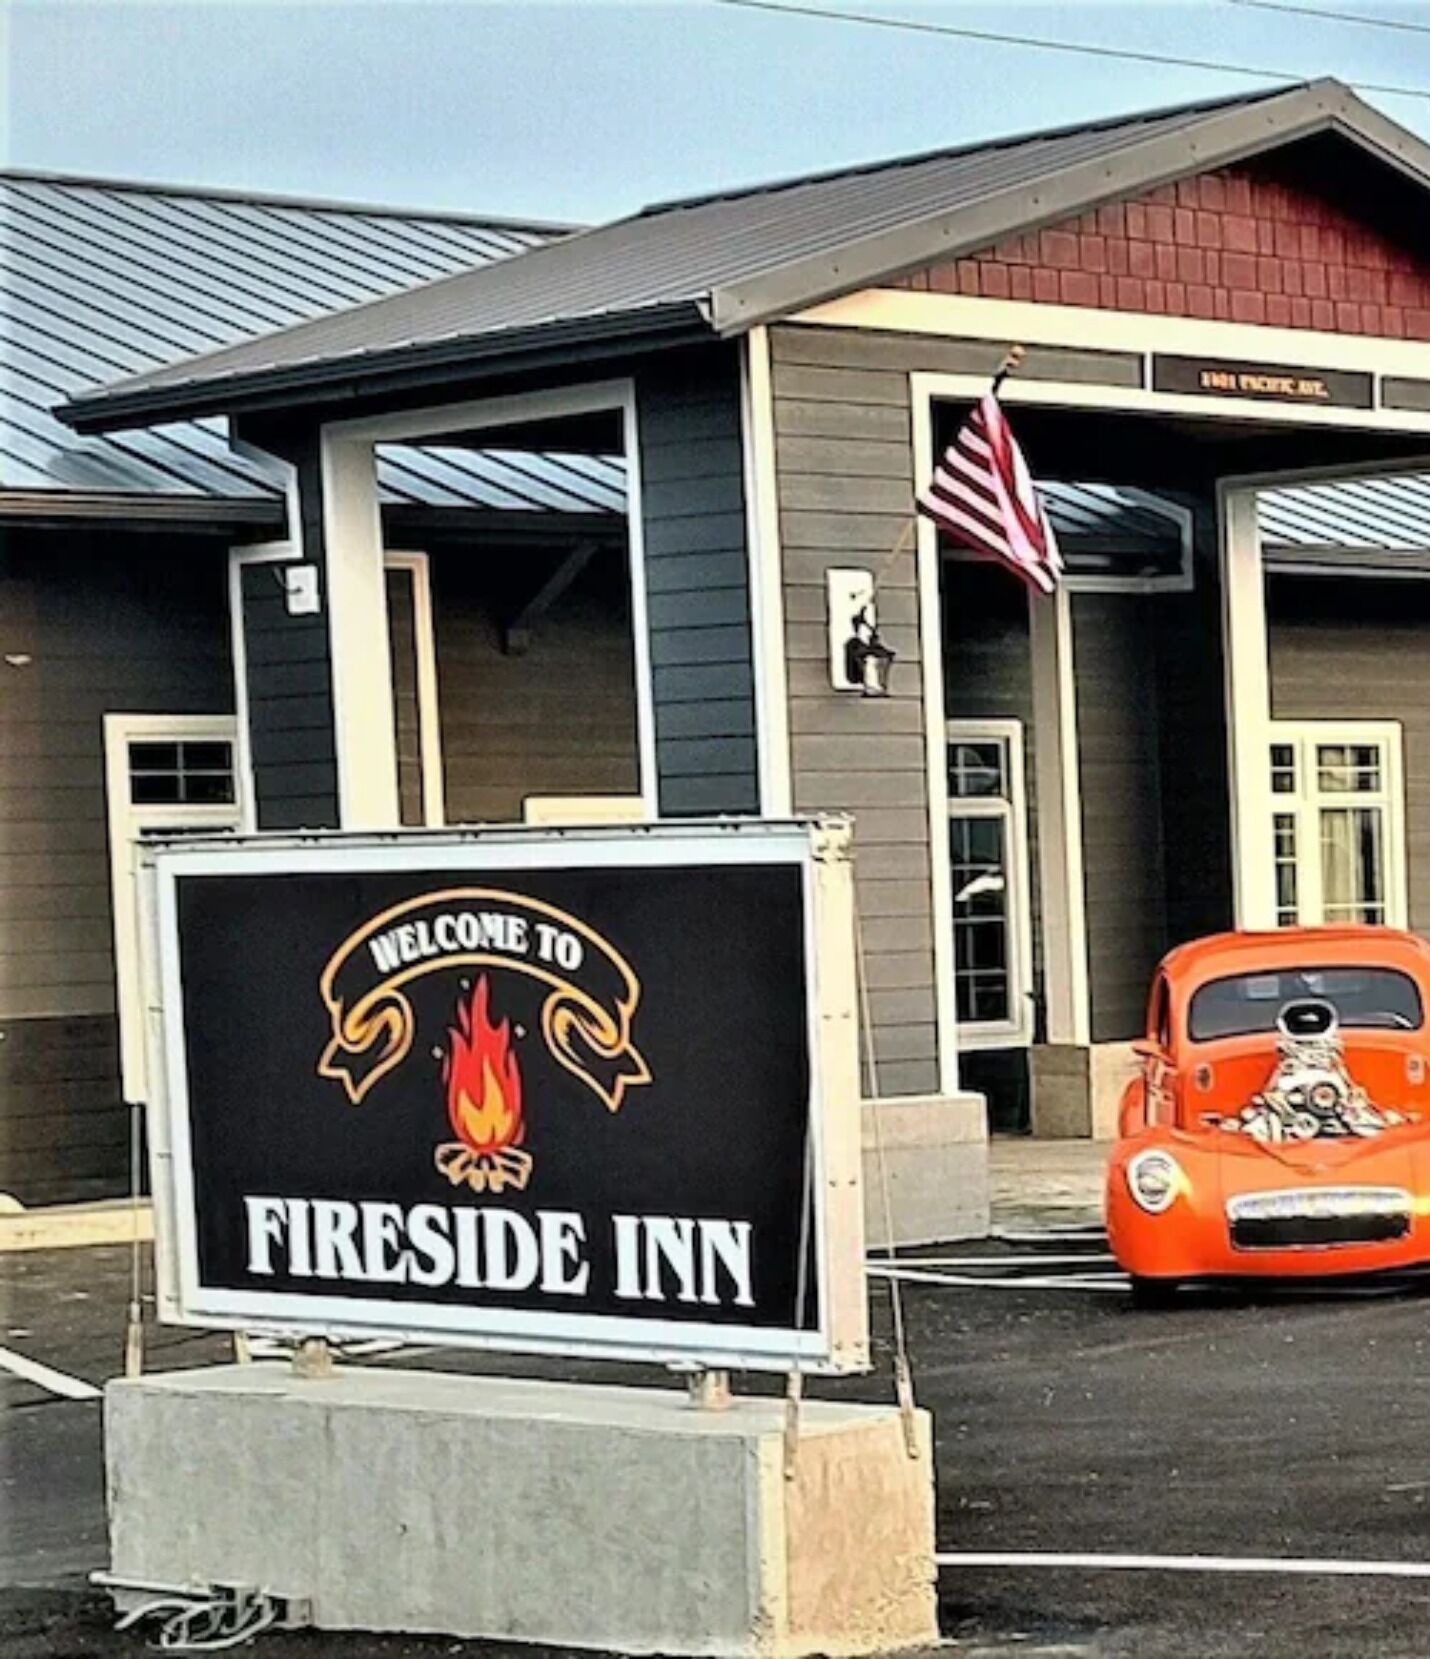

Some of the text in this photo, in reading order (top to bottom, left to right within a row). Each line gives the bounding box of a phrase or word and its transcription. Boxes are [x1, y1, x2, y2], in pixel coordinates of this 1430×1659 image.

[1239, 374, 1294, 395] PACIFIC
[370, 913, 582, 972] WELCOME TO
[244, 1197, 755, 1306] FIRESIDE INN
